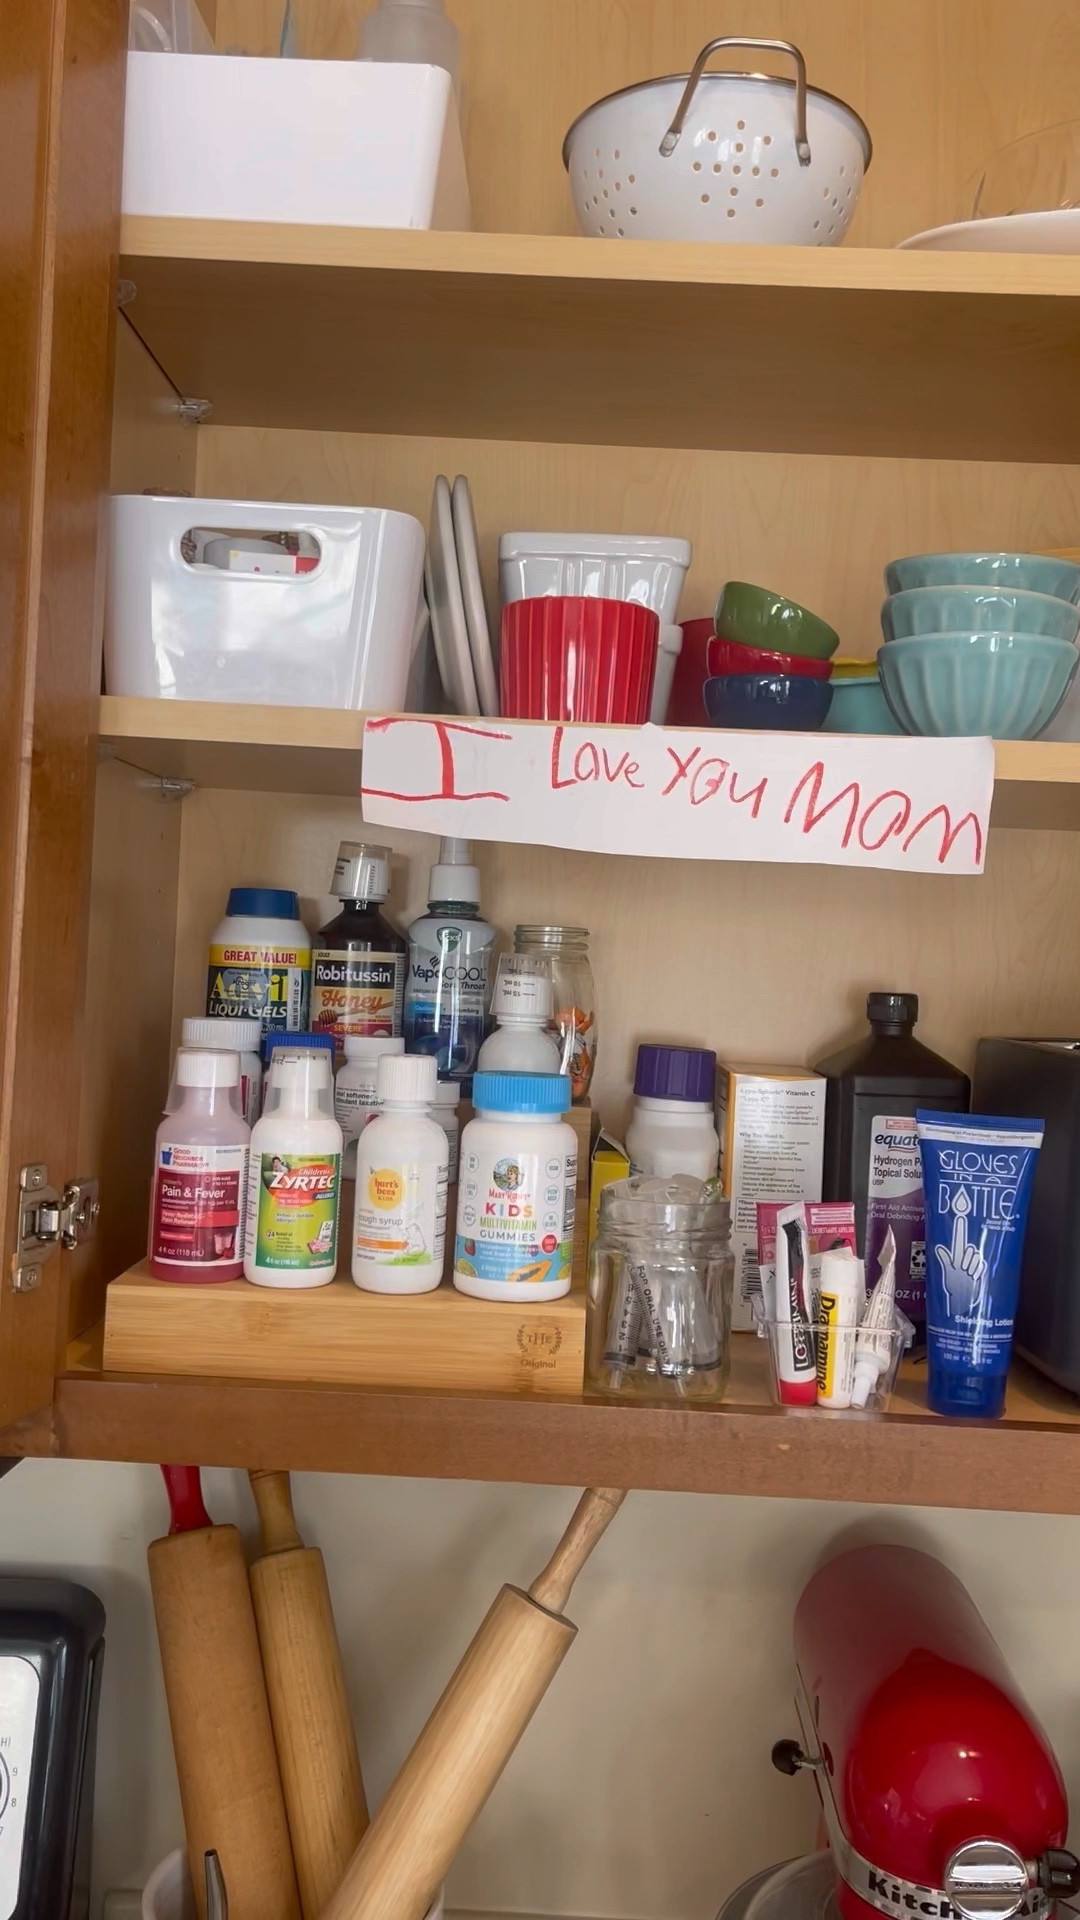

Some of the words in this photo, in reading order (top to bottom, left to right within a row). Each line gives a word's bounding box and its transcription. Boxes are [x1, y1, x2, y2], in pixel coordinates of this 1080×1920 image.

[362, 718, 513, 802] I
[661, 746, 769, 819] You
[785, 760, 982, 866] Mom
[224, 950, 257, 962] GREAT
[261, 951, 297, 964] VALUE!
[317, 965, 391, 983] Robitussin
[321, 990, 384, 1014] Honey
[874, 1134, 920, 1148] equat
[873, 1155, 913, 1167] Hydrogen
[938, 1149, 1019, 1175] GLOVES
[873, 1167, 902, 1178] Topical
[270, 1171, 336, 1192] ZYRTEC
[162, 1184, 182, 1197] Pain
[183, 1186, 192, 1198] &
[195, 1187, 226, 1198] Fever
[377, 1188, 396, 1196] bees
[485, 1201, 533, 1218] KIDS
[870, 1211, 886, 1219] Oral
[379, 1217, 404, 1226] syrup
[479, 1216, 538, 1232] MULTIVITAMIN
[479, 1229, 536, 1242] GUMMIES
[520, 1359, 557, 1369] Original
[11, 1797, 17, 1808] 8
